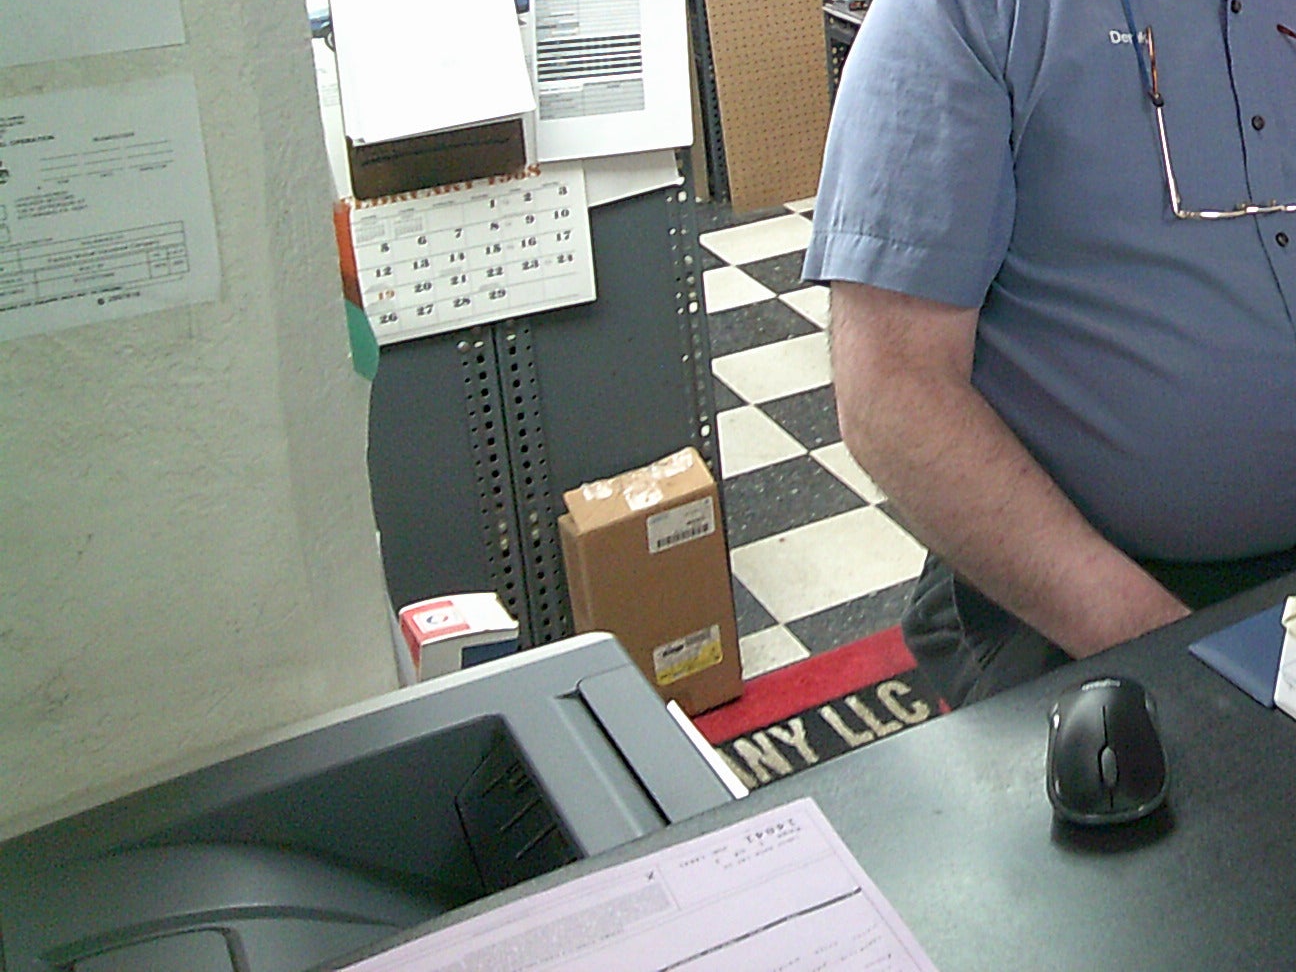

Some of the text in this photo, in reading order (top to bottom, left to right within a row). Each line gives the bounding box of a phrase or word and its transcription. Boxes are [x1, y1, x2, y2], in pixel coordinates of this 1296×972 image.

[490, 199, 495, 209] 1
[523, 192, 532, 202] 2
[417, 235, 427, 245] 6
[455, 228, 463, 239] 7
[490, 222, 500, 231] 8
[525, 215, 535, 224] 9
[554, 209, 570, 219] 10
[375, 230, 572, 278] 12 13 14 15 16 17
[378, 254, 573, 301] 19 20 21 22 23 24
[380, 289, 506, 324] 26 27 28 29
[819, 679, 931, 747] LLC
